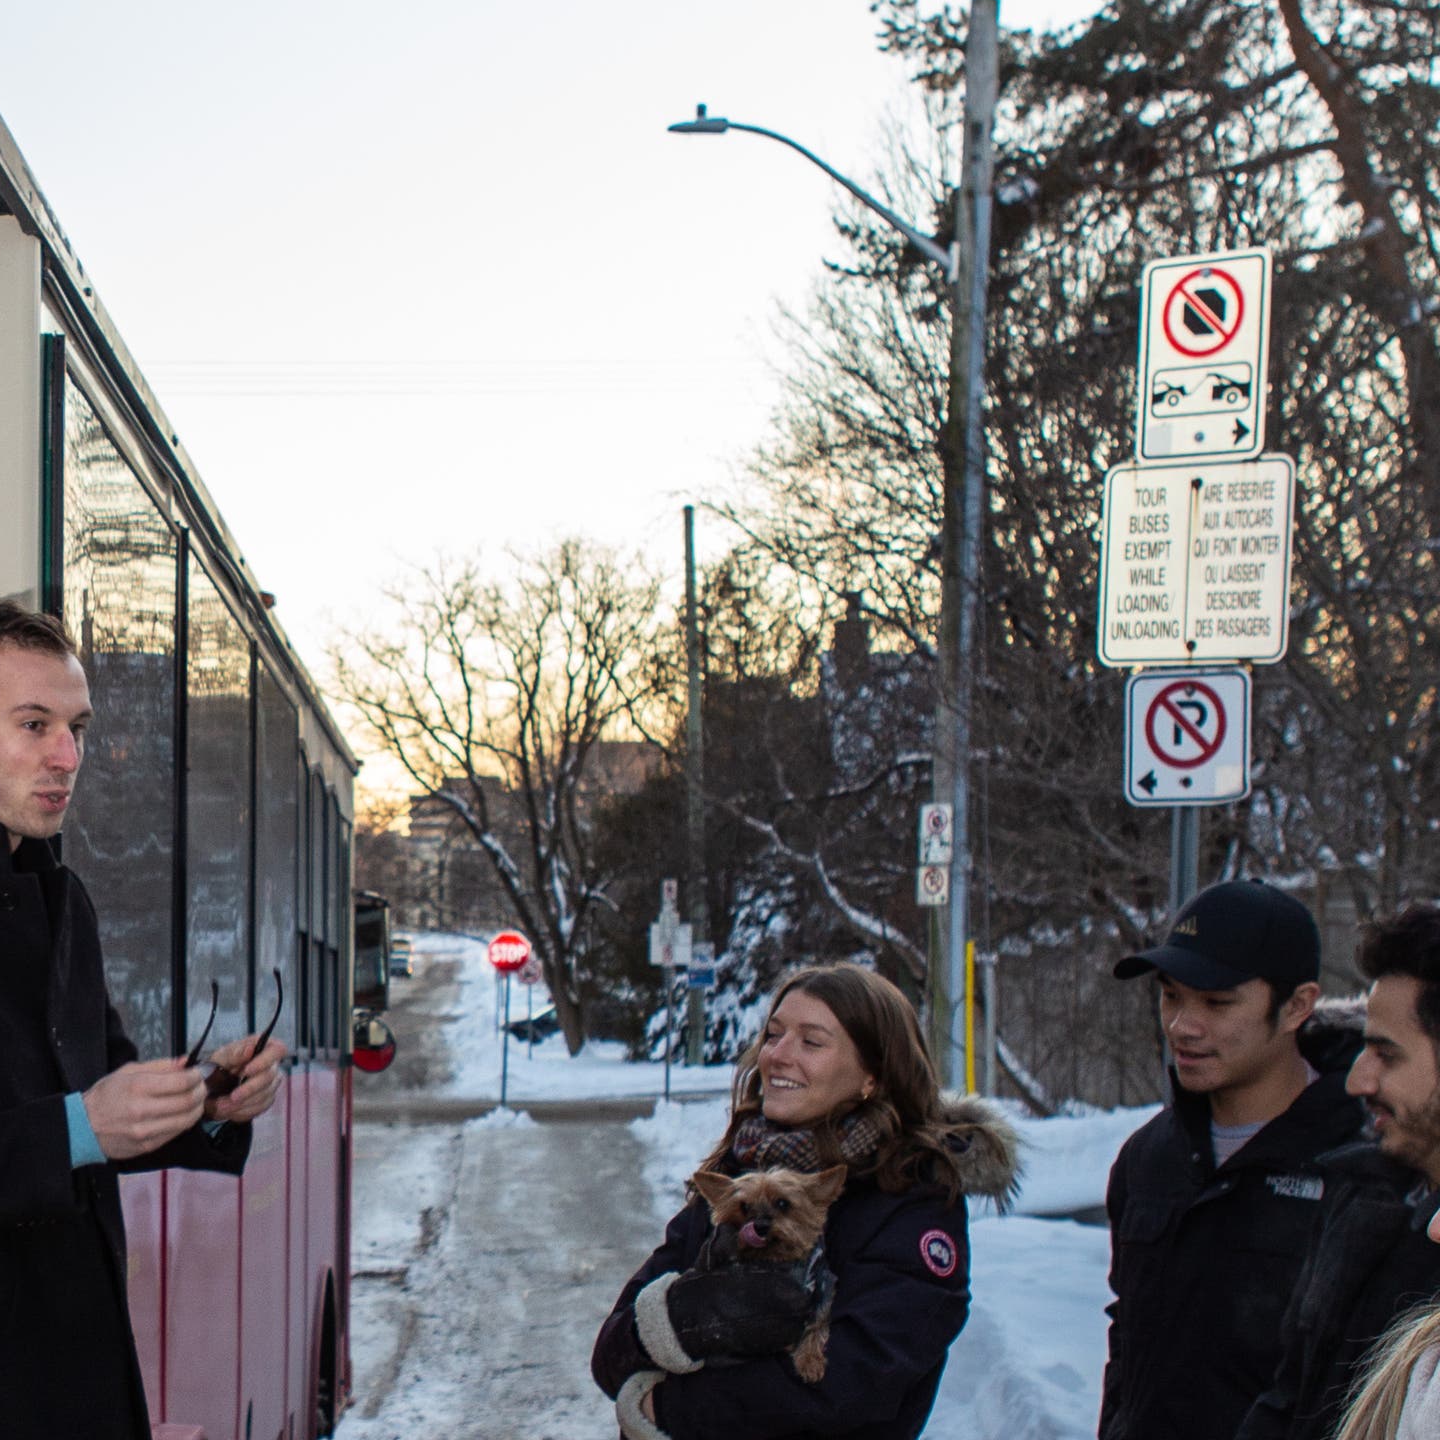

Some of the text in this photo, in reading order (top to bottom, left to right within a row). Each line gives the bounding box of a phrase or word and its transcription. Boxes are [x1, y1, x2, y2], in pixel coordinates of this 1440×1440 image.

[1136, 488, 1167, 507] TOUR
[1204, 483, 1224, 503] AIRE
[1129, 514, 1169, 534] BUSES
[1204, 508, 1273, 529] AUX AUTOCARS
[1125, 540, 1172, 561] EXEMPT
[1194, 535, 1280, 558] QUI FONT MONTER
[1130, 567, 1166, 587] WHILE
[1204, 563, 1266, 584] OU LAISSENT
[1207, 590, 1262, 611] DESCENDRE
[1112, 620, 1180, 640] UNLOADING
[1195, 617, 1271, 638] DES PASSAGERS
[491, 944, 527, 962] STOP
